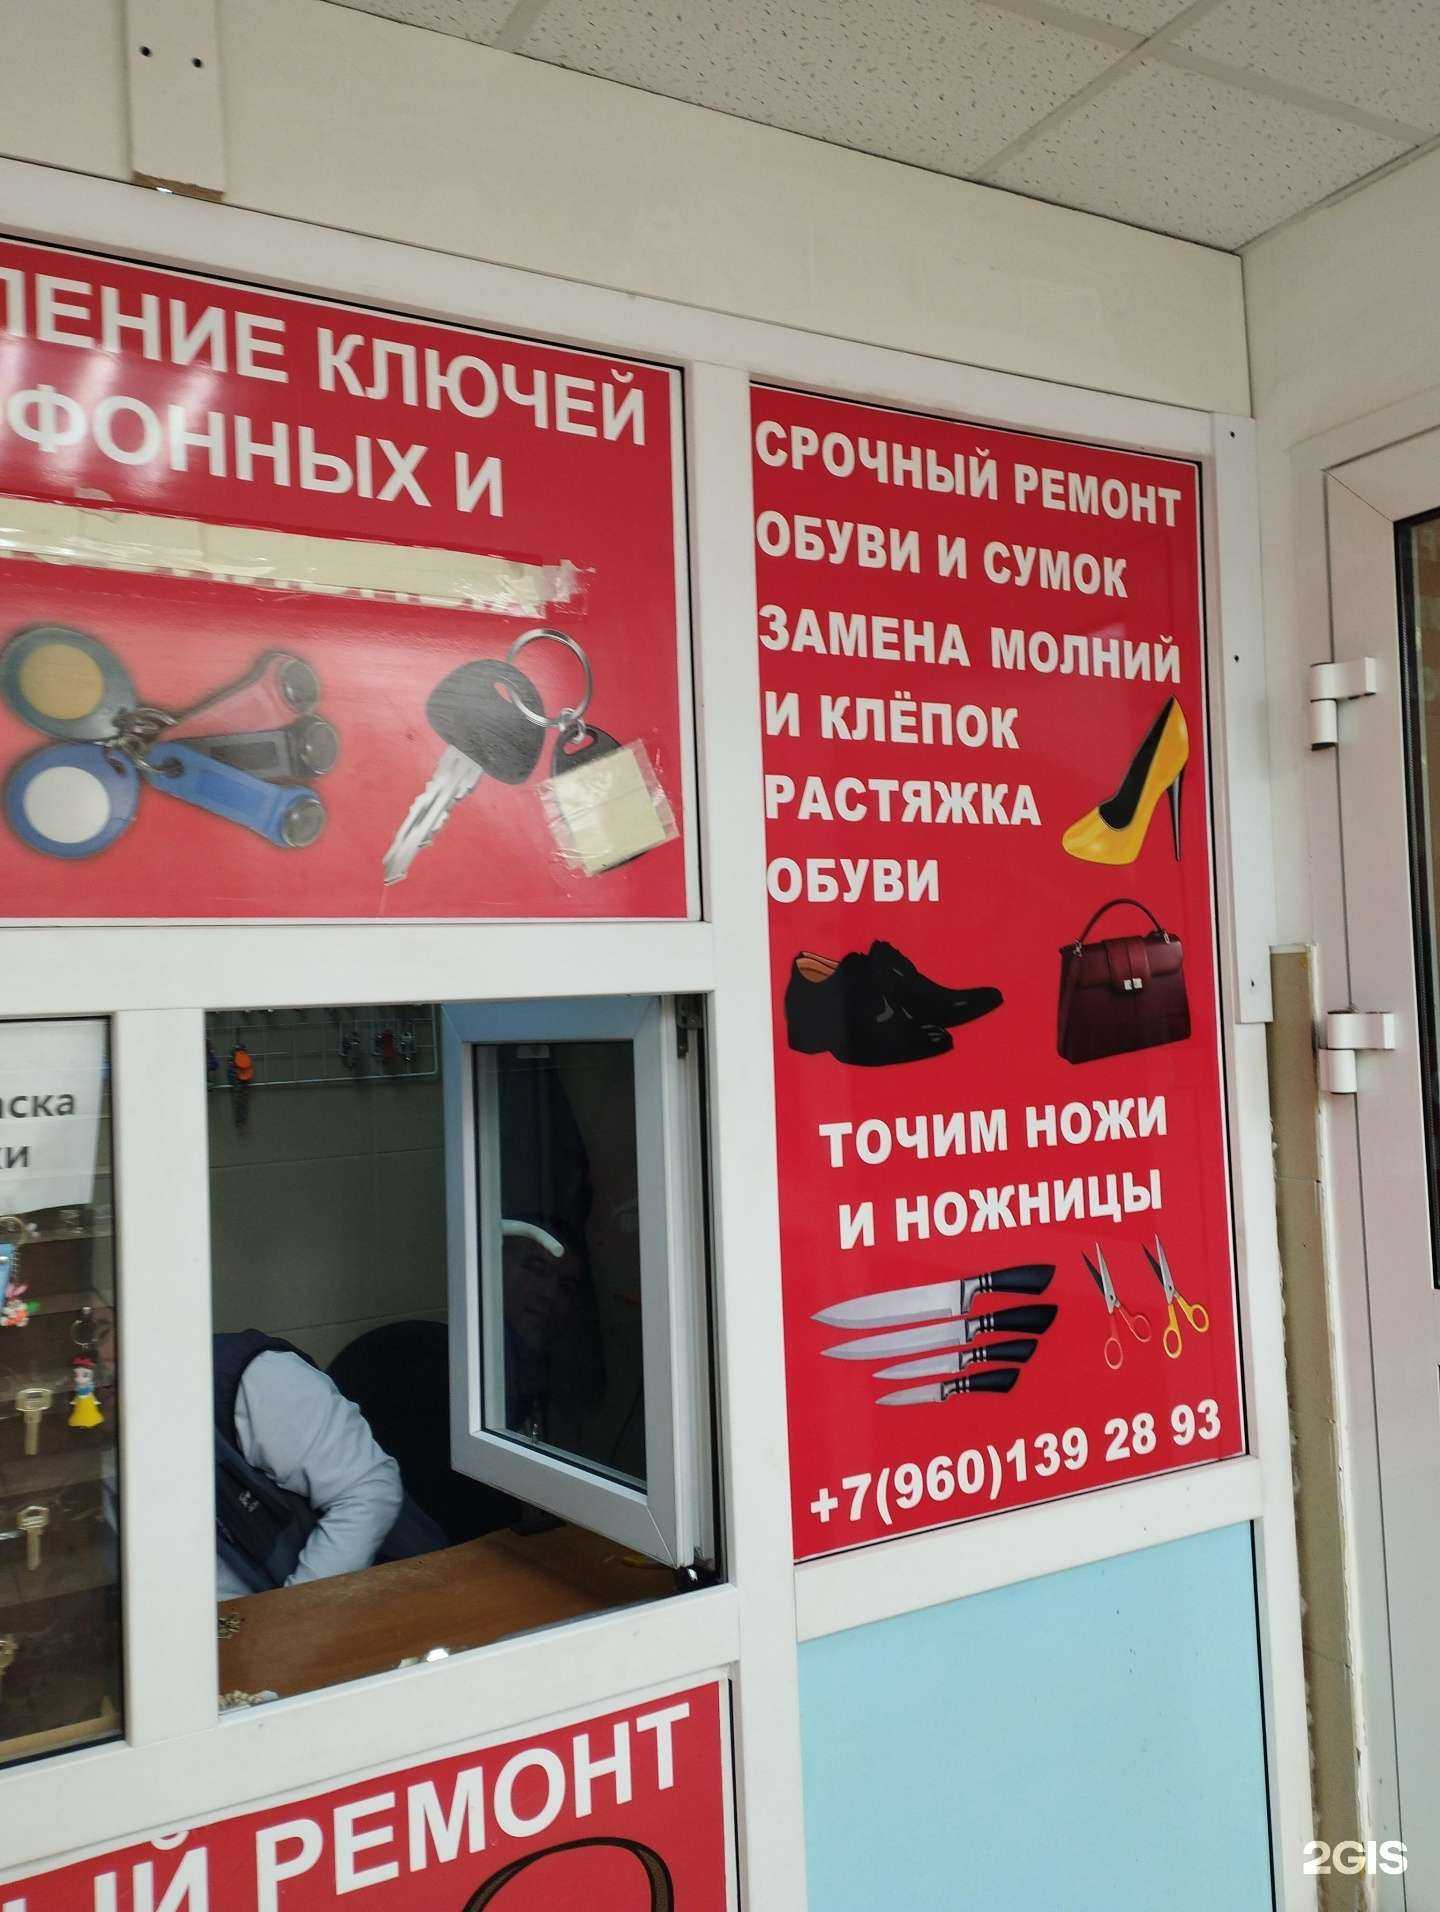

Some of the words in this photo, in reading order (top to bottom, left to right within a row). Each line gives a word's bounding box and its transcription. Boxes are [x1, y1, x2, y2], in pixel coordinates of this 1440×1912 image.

[317, 327, 645, 446] КЛЮЧЕЙ
[455, 451, 504, 517] И
[755, 420, 998, 500] СРОЧНЫЙ
[1014, 463, 1182, 527] РЕМОНТ
[756, 510, 920, 573] ОБУВИ
[937, 534, 967, 579] И
[983, 543, 1128, 598] СУМОК
[758, 604, 971, 668] ЗАМЕНА
[991, 627, 1181, 684] МОЛНИЙ
[765, 691, 800, 737] И
[820, 690, 1020, 750] КЛЁПОК
[765, 774, 1042, 826] РАСТЯЖКА
[766, 857, 940, 903] ОБУВИ
[0, 1093, 76, 1119] ска
[819, 1108, 1008, 1168] ТОЧИМ
[1025, 1095, 1168, 1150] НОЖИ
[838, 1202, 876, 1250] И
[895, 1169, 1162, 1242] НОЖНИЦЫ
[810, 1426, 1089, 1525] +7(960)139
[1104, 1412, 1157, 1461] 28
[1171, 1398, 1222, 1446] 93
[255, 1702, 691, 1912] РЕМОНТ
